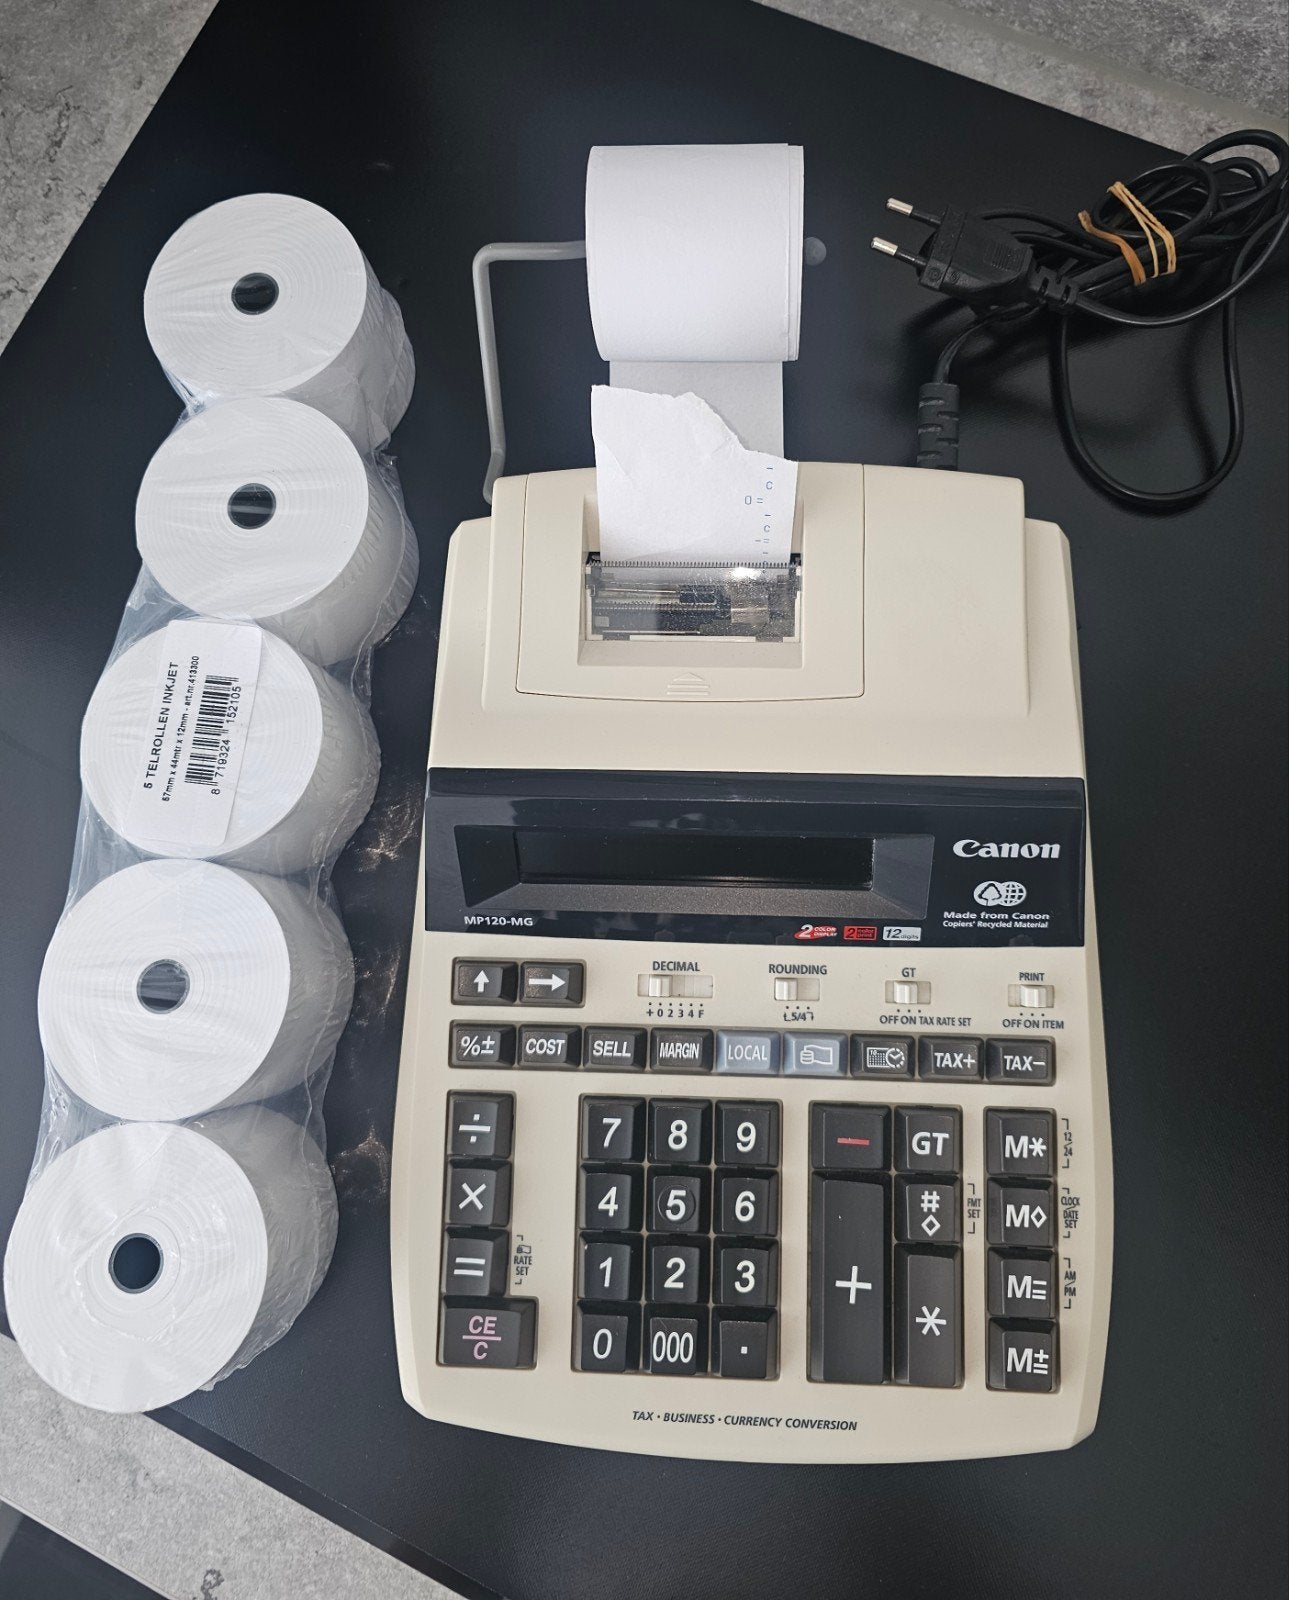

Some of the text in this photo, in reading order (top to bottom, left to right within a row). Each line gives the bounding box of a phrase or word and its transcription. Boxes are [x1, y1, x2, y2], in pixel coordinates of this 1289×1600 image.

[146, 708, 170, 779] TELROLLEN
[163, 662, 178, 704] INKJET
[215, 739, 231, 778] 719324
[226, 686, 242, 724] 152105
[170, 746, 182, 769] 44mtr
[177, 713, 189, 737] 12mm
[952, 839, 1061, 859] Canon
[463, 915, 534, 927] MP120-MG
[943, 911, 1050, 920] Made from Canon
[799, 924, 813, 938] 2
[846, 928, 856, 939] 2
[885, 928, 902, 939] 12
[977, 920, 1012, 930] Recycled
[1013, 921, 1048, 929] Material
[652, 961, 700, 972] DECIMAL
[768, 963, 827, 975] ROUNDING
[902, 967, 916, 978] GT
[1019, 972, 1045, 982] PRINT
[879, 1015, 971, 1027] OFF ON TAX RATE SET
[1002, 1018, 1064, 1030] OFF ON ITEM
[525, 1038, 566, 1055] COST
[592, 1041, 631, 1058] SELL
[659, 1042, 700, 1059] MARGIN
[727, 1044, 768, 1061] LOCAL
[934, 1052, 976, 1069] TAX+
[602, 1117, 622, 1148] 7
[668, 1119, 688, 1150] 8
[736, 1121, 756, 1153] 9
[911, 1131, 949, 1156] GT
[597, 1186, 618, 1217] 4
[665, 1189, 687, 1221] 5
[735, 1190, 756, 1222] 6
[967, 1198, 982, 1208] FMT
[1061, 1197, 1080, 1206] CLOCK
[967, 1209, 981, 1219] SET
[1063, 1210, 1079, 1220] DATE
[1064, 1220, 1077, 1228] SET
[514, 1256, 532, 1265] RATE
[516, 1266, 529, 1276] SET
[599, 1256, 613, 1288] 1
[664, 1257, 686, 1289] 2
[734, 1260, 756, 1293] 3
[1064, 1271, 1077, 1281] AM
[1064, 1287, 1077, 1297] PM
[468, 1315, 498, 1335] CE
[473, 1341, 489, 1360] C
[593, 1328, 612, 1359] 0
[652, 1331, 694, 1363] 000
[632, 1411, 858, 1431] TAX BUSINESS CURRENCY CONVERSION
